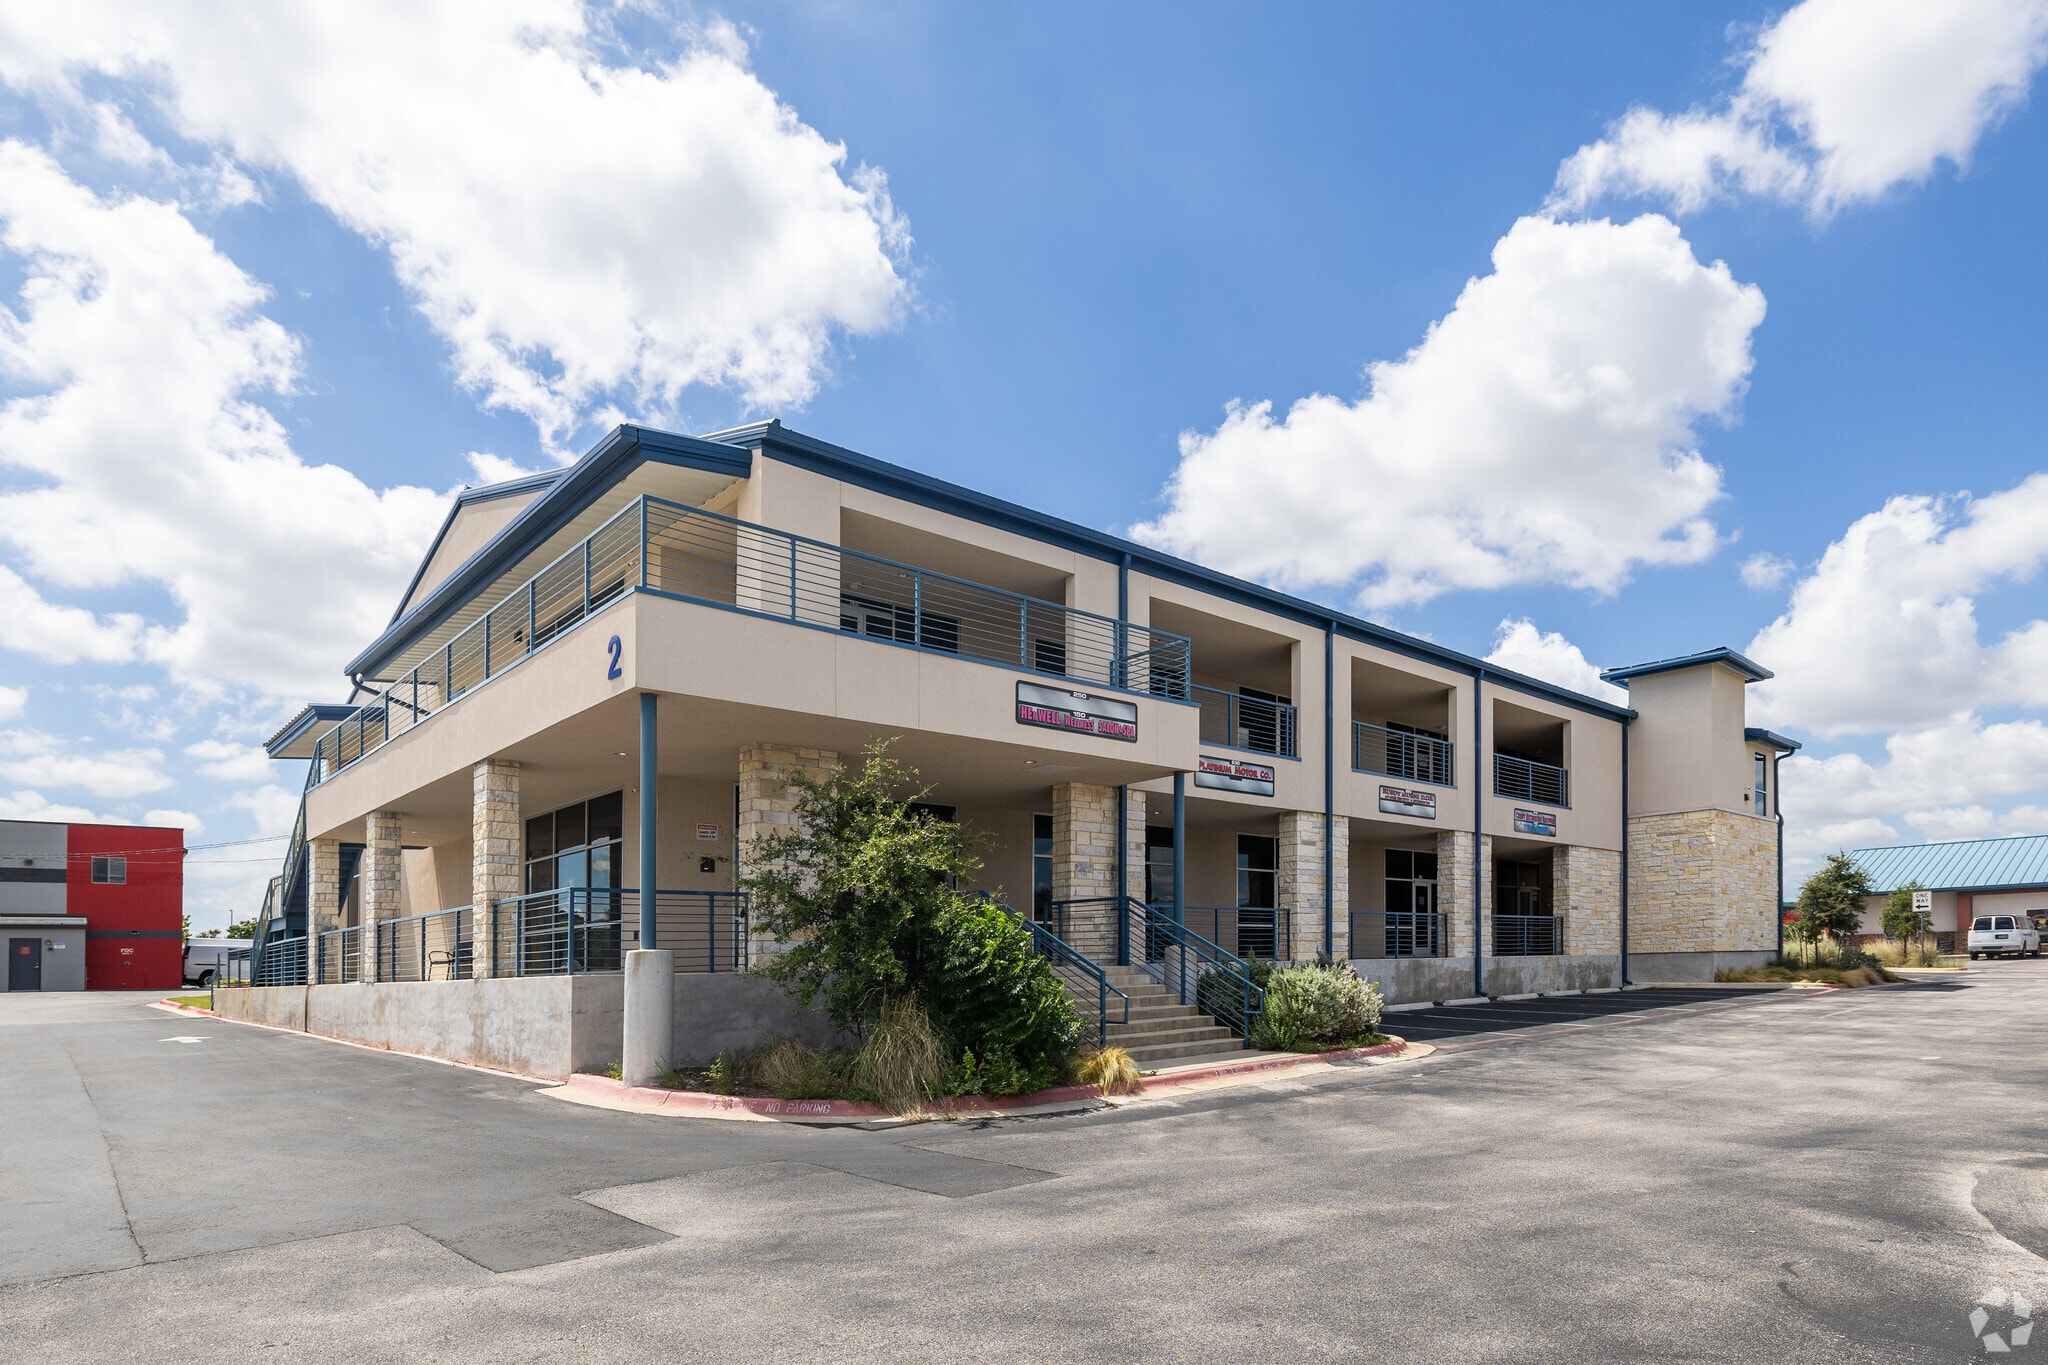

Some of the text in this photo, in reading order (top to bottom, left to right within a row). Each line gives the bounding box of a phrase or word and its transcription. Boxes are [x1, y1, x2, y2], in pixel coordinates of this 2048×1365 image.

[608, 634, 622, 680] 2
[1064, 714, 1095, 731] WELLNESS
[1199, 760, 1232, 774] PLATINUM
[1234, 766, 1258, 778] MOTOR
[765, 1102, 781, 1113] NO
[786, 1103, 831, 1114] PARKING
